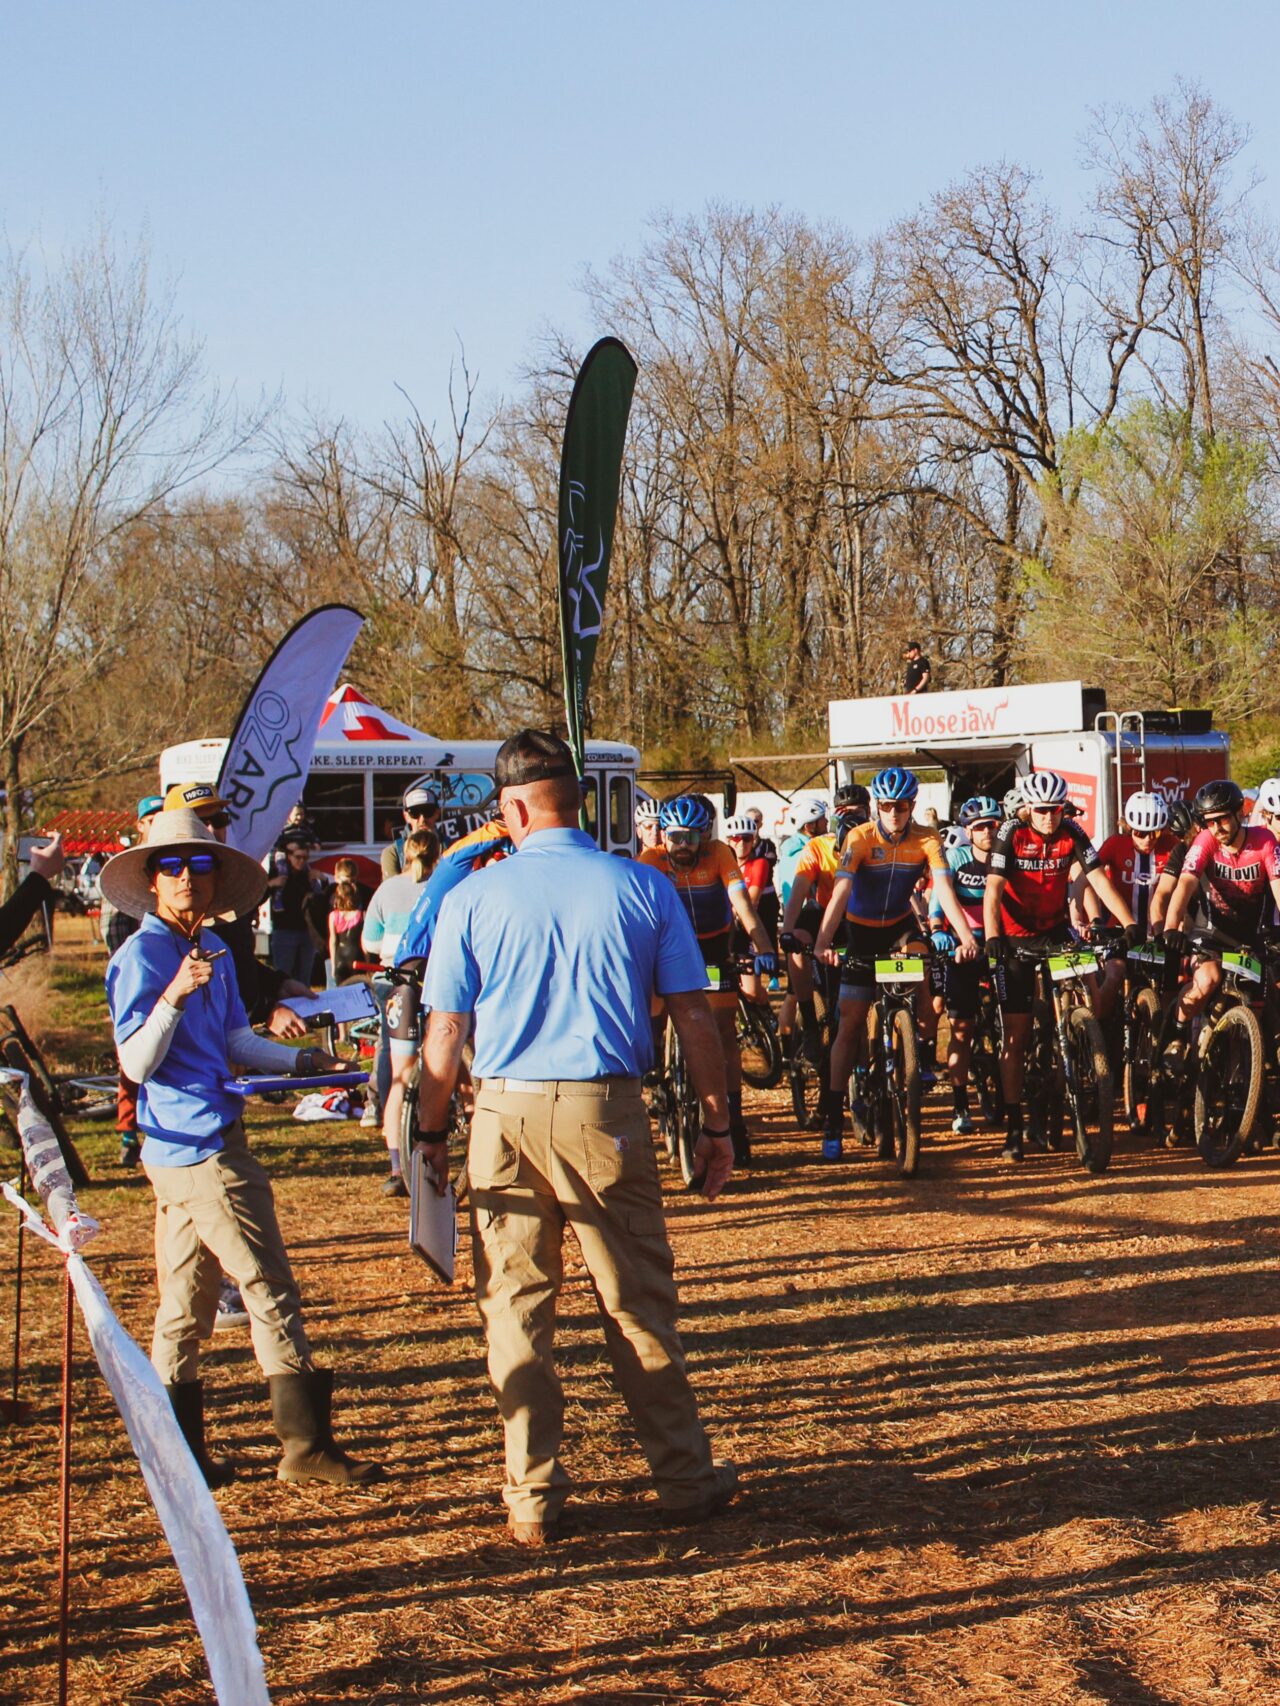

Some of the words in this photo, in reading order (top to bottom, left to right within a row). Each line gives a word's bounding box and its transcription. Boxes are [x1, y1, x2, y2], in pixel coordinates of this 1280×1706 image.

[891, 695, 1009, 738] Moosejaw
[309, 754, 333, 767] IKE.
[335, 754, 375, 766] SLEEP.
[377, 754, 426, 766] REPEAT.
[957, 871, 988, 887] TCCX
[895, 960, 904, 973] 8
[1238, 954, 1252, 969] 16
